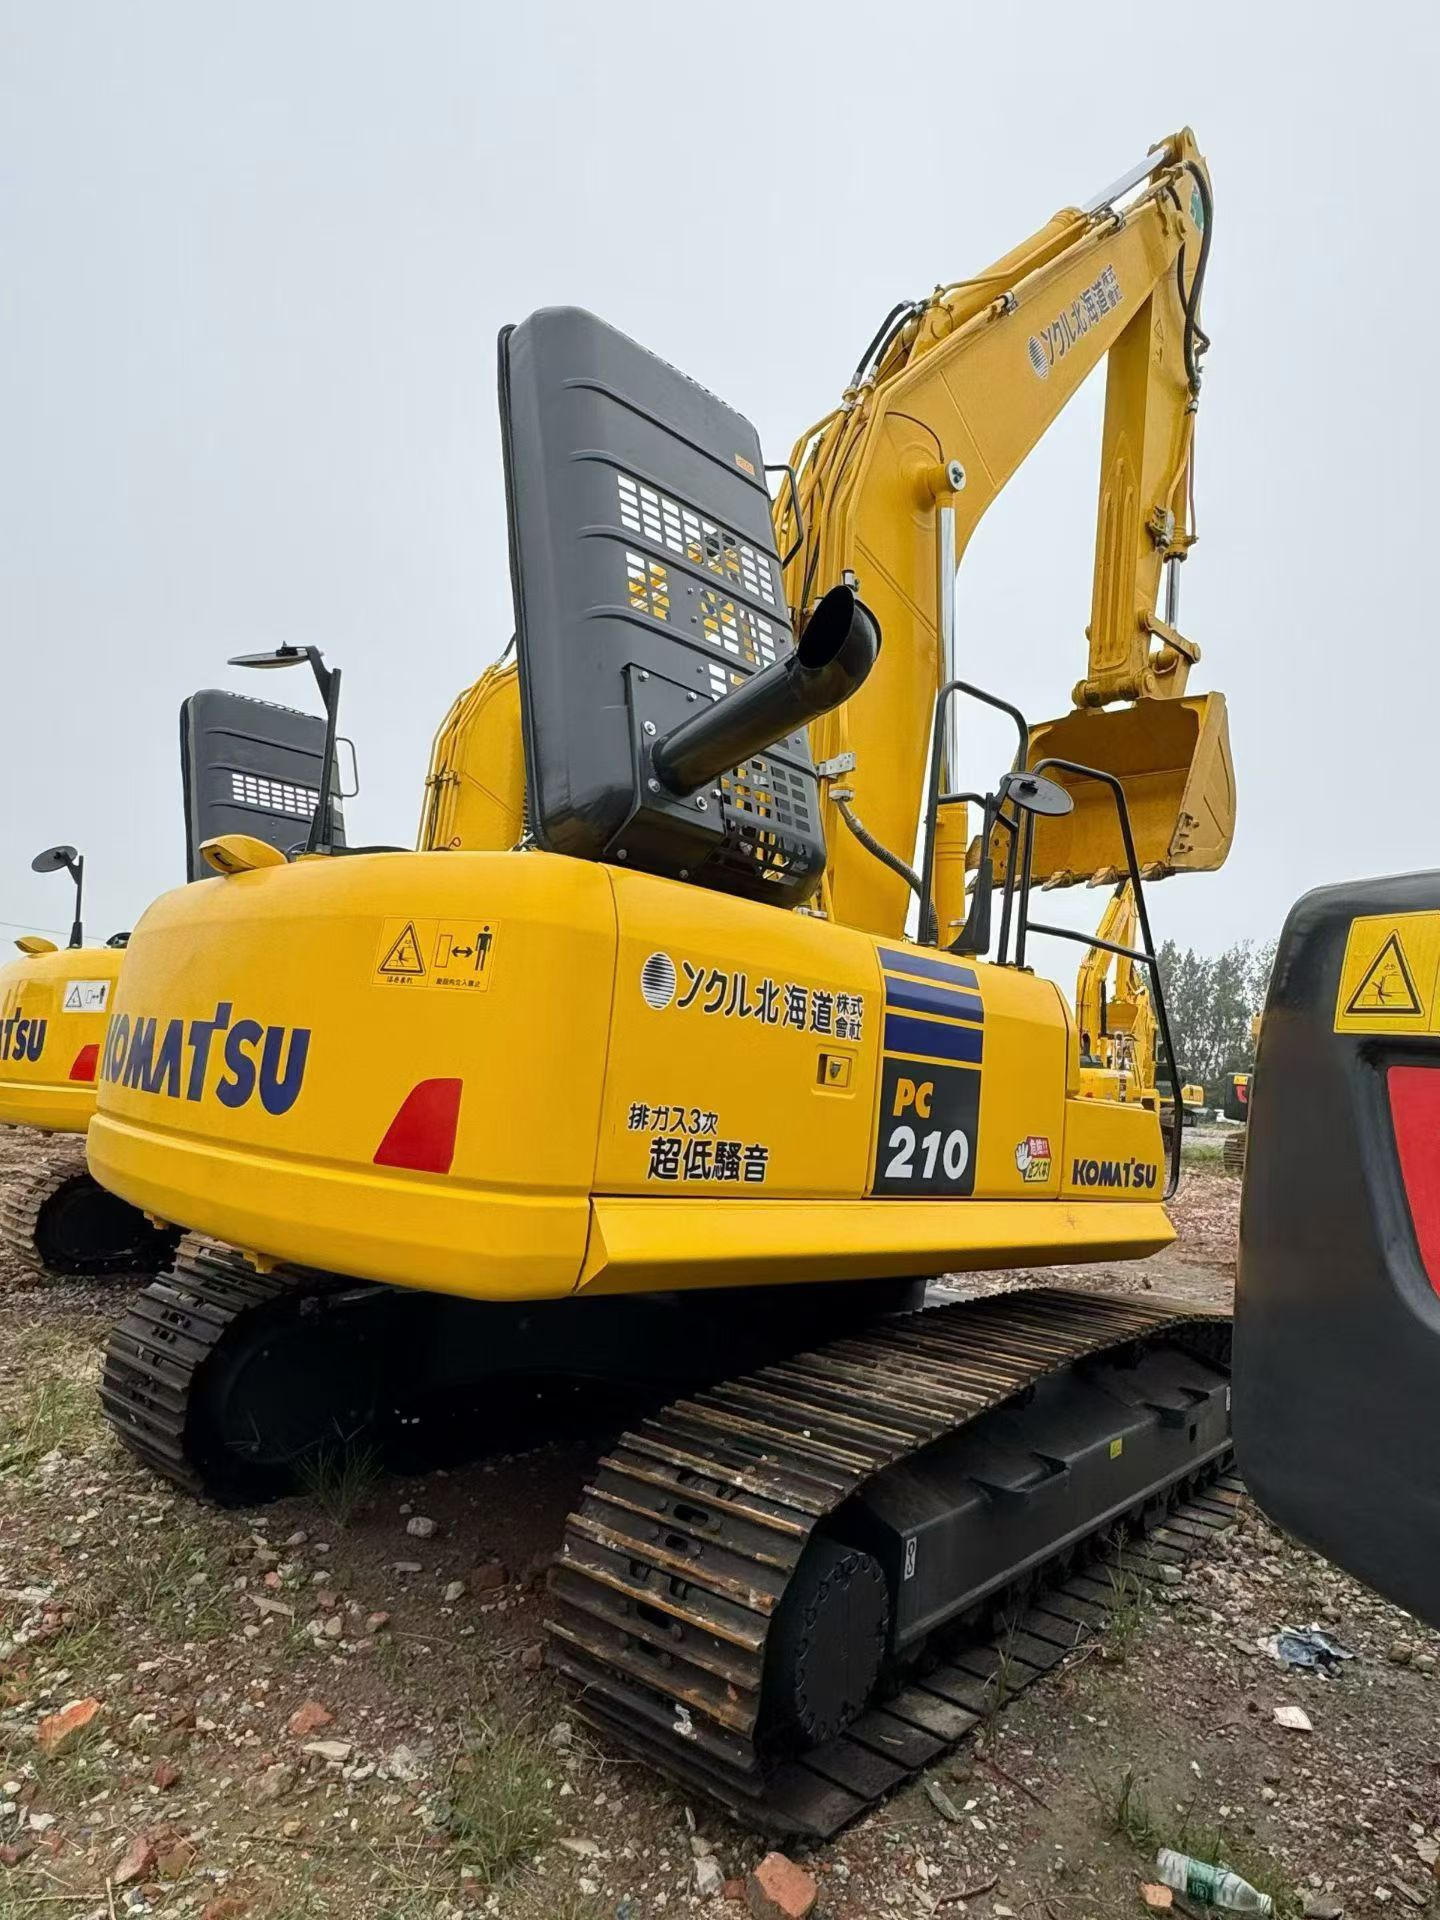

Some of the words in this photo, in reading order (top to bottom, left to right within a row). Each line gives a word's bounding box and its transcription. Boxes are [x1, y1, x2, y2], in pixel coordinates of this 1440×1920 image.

[0, 1007, 48, 1062] TSU
[101, 1002, 311, 1115] KOMATSU
[628, 1103, 718, 1134] 排ガス3次
[893, 1078, 933, 1118] PC
[884, 1125, 969, 1180] 210
[1072, 1157, 1157, 1188] KOMATSU
